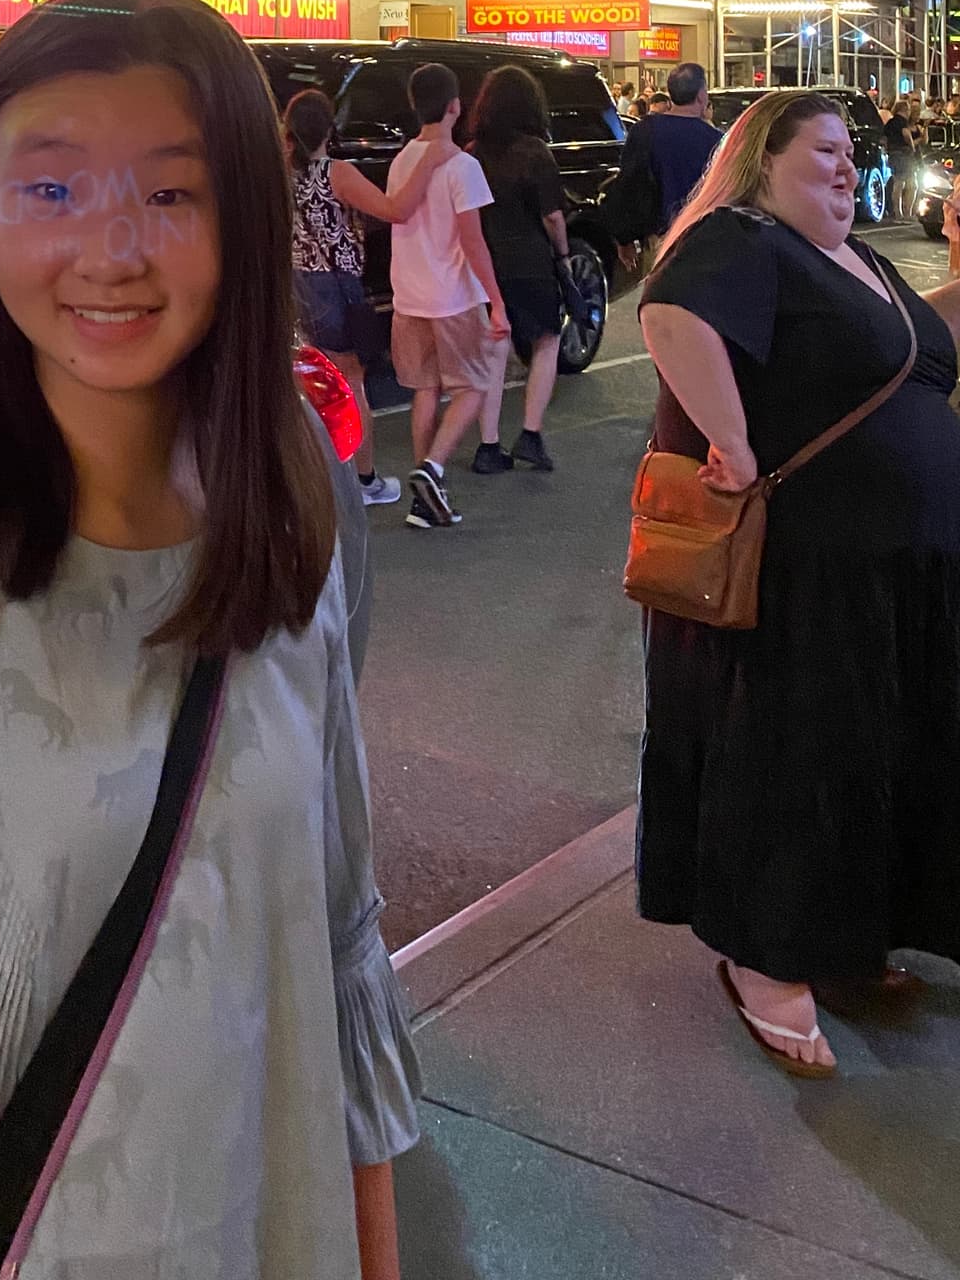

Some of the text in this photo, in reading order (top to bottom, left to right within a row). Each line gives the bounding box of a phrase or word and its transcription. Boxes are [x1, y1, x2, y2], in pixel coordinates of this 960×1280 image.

[474, 10, 502, 26] GO
[506, 10, 530, 25] TO
[534, 9, 566, 25] THE
[571, 7, 640, 24] WOOD!
